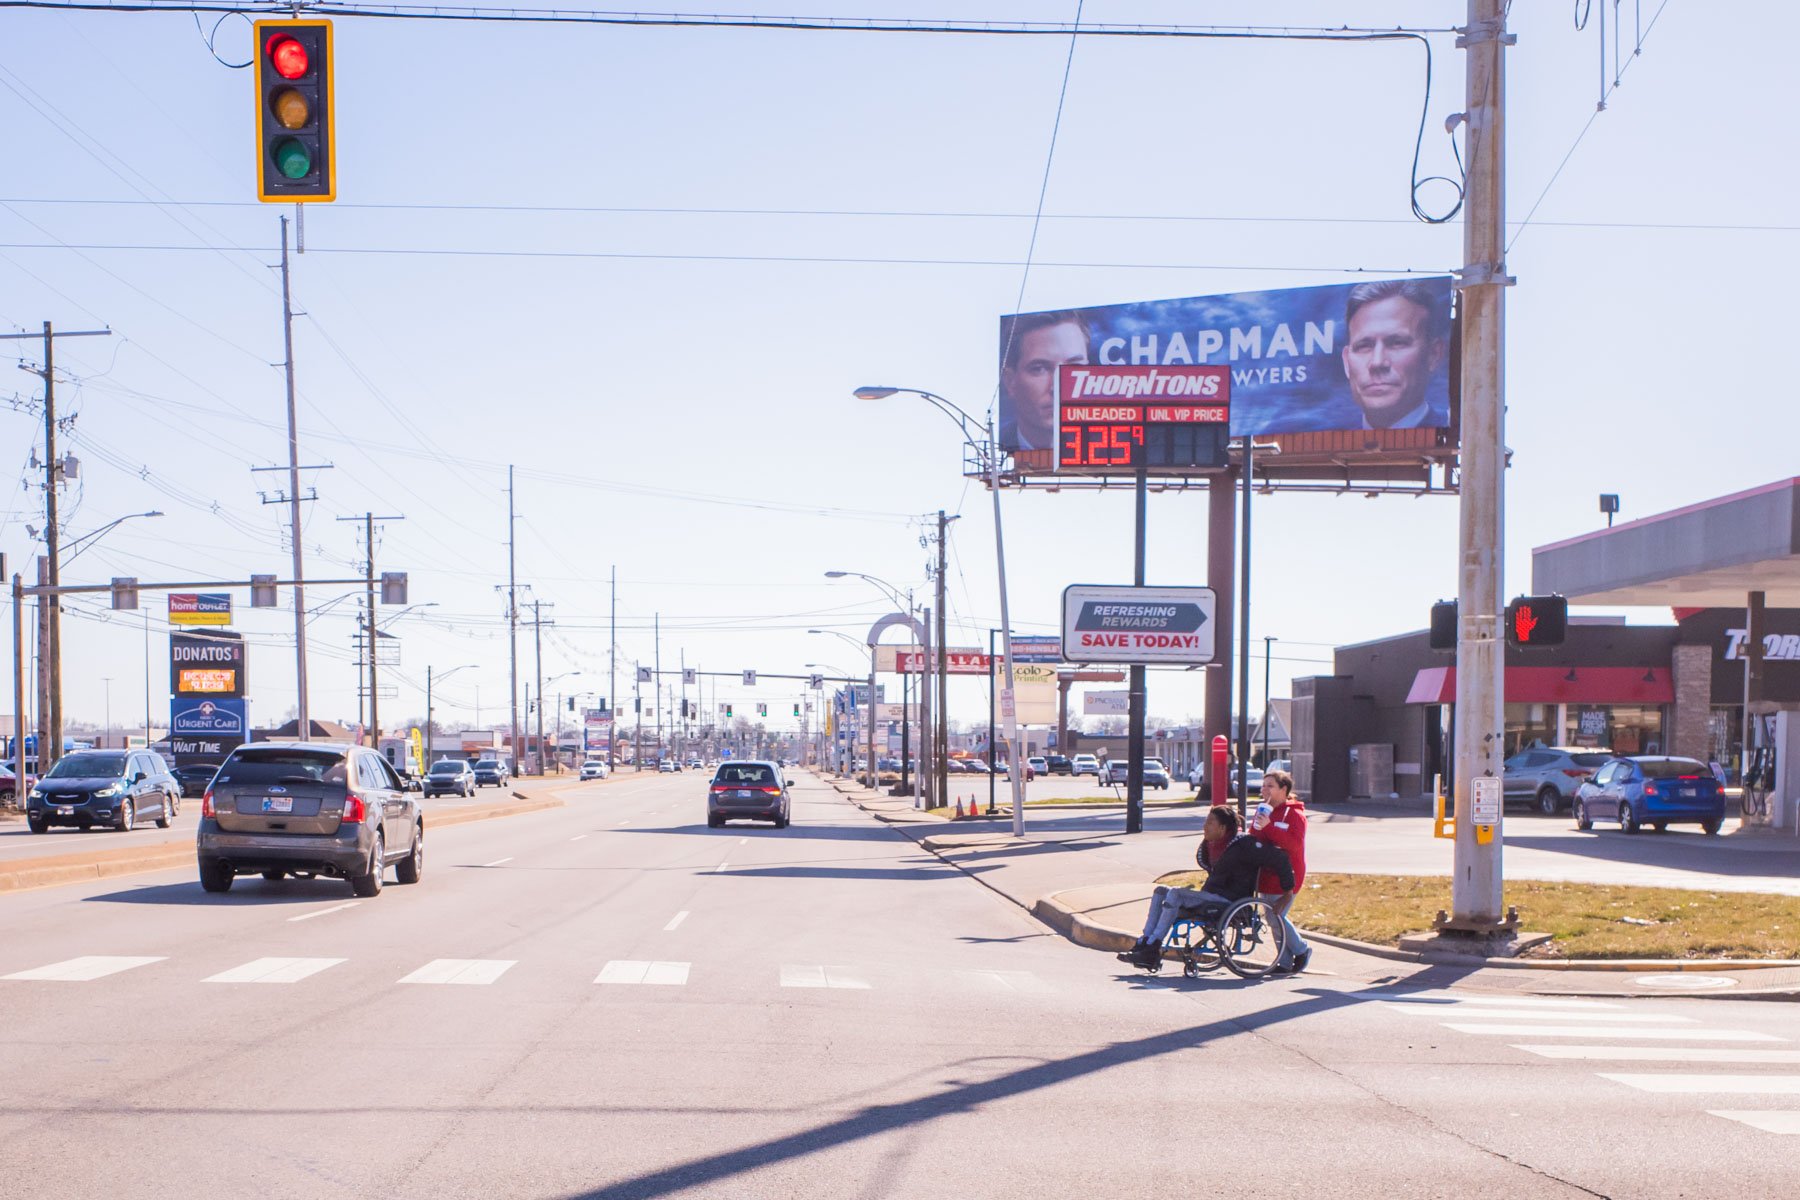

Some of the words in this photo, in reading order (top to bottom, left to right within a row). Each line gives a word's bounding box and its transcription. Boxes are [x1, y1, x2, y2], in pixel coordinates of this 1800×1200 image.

[1099, 320, 1335, 366] CHAPMAN
[1231, 364, 1308, 387] WYERS
[1070, 369, 1221, 399] THORNTONS
[1067, 408, 1136, 421] UNLEADED
[1150, 408, 1171, 421] UNL
[1174, 409, 1191, 421] VIP
[1193, 409, 1224, 421] PRICE
[171, 599, 198, 611] home
[1093, 605, 1177, 617] REFRESHING
[1101, 616, 1169, 628] REWARDS
[1080, 634, 1129, 647] SAVE
[1133, 634, 1200, 649] TODAY!
[173, 646, 232, 661] DONATOS
[1582, 711, 1606, 720] MADE
[178, 719, 212, 728] URGENT
[214, 718, 238, 728] CARE
[1581, 720, 1606, 729] FRESH
[173, 741, 197, 753] WAIT
[198, 741, 221, 753] TIME
